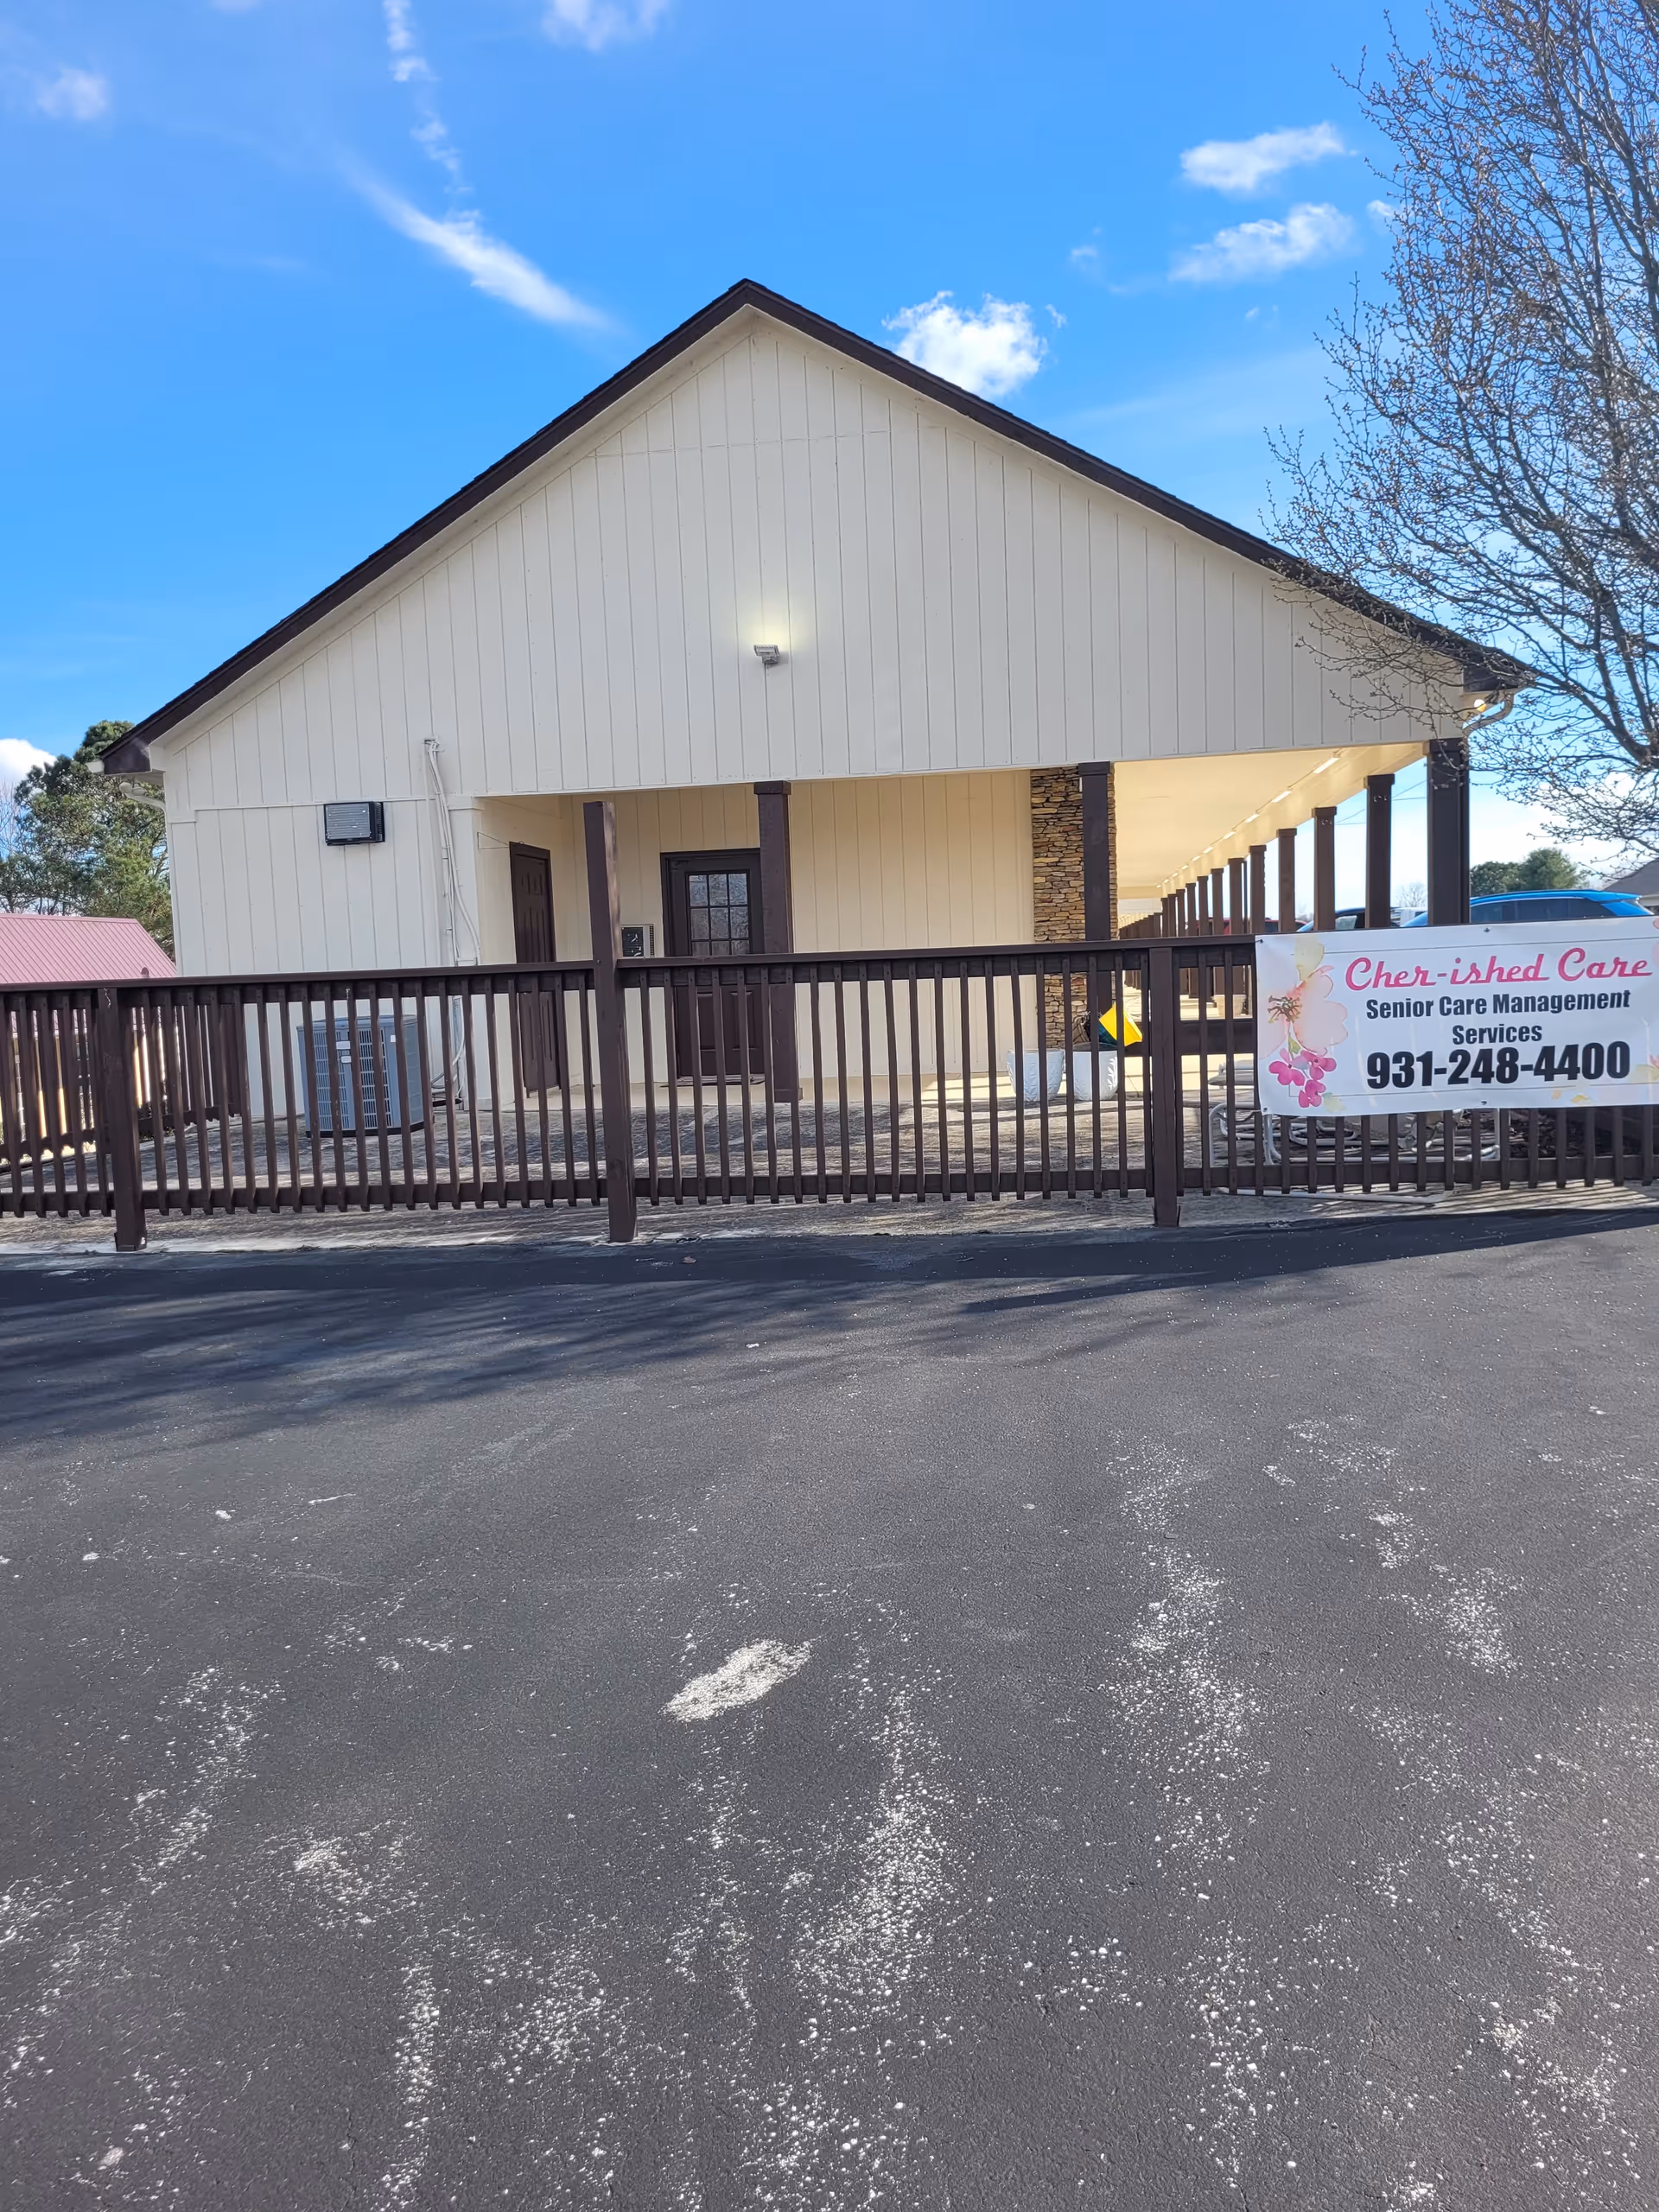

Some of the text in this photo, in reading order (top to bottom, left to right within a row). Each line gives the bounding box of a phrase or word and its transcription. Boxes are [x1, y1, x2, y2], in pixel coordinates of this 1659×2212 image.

[1345, 948, 1652, 991] Cher-ished Care
[1367, 989, 1630, 1019] Senior Care Management
[1452, 1025, 1541, 1045] Services
[1367, 1041, 1630, 1089] 931-248-4400
